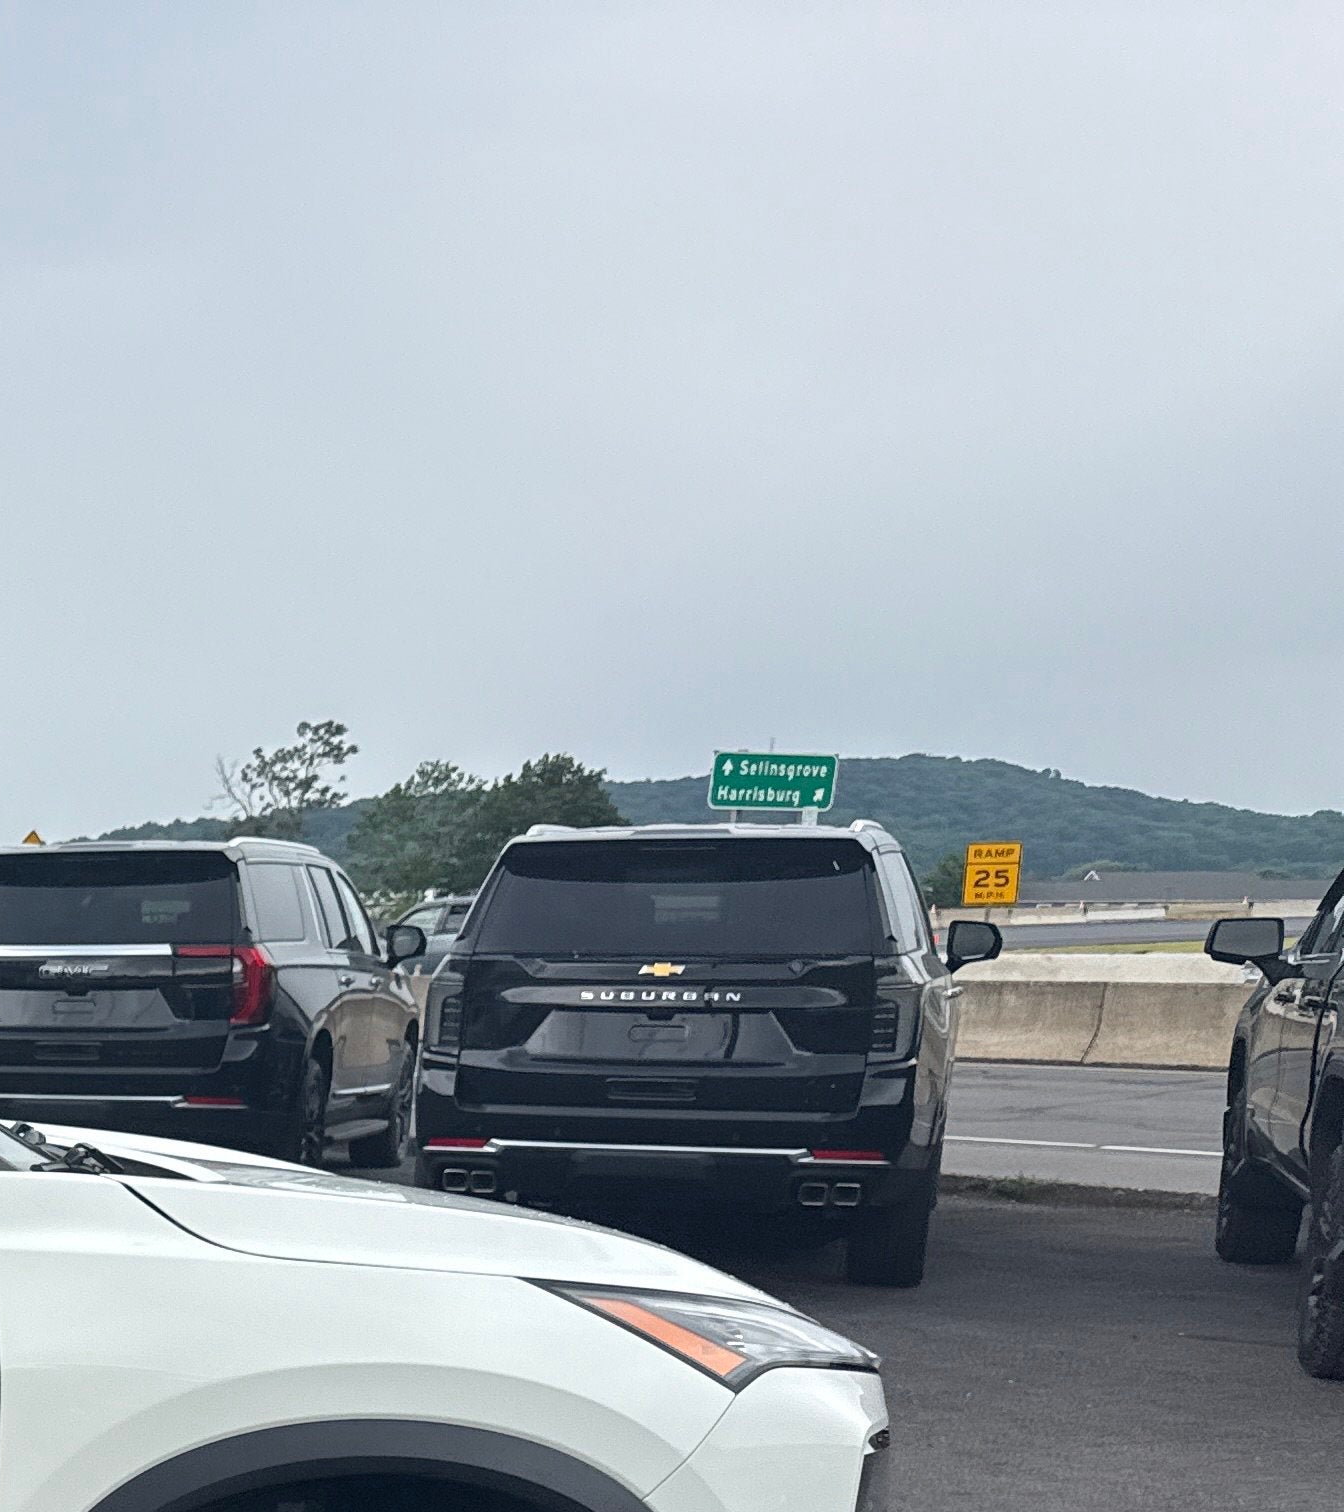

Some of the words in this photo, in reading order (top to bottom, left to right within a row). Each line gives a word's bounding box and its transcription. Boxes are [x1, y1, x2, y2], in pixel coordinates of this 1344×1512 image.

[739, 759, 828, 781] Selinsgrove
[717, 785, 801, 807] Harrisburg
[973, 848, 1015, 859] RAMP
[973, 869, 1010, 888] 25
[580, 990, 741, 1002] SUBURBAN
